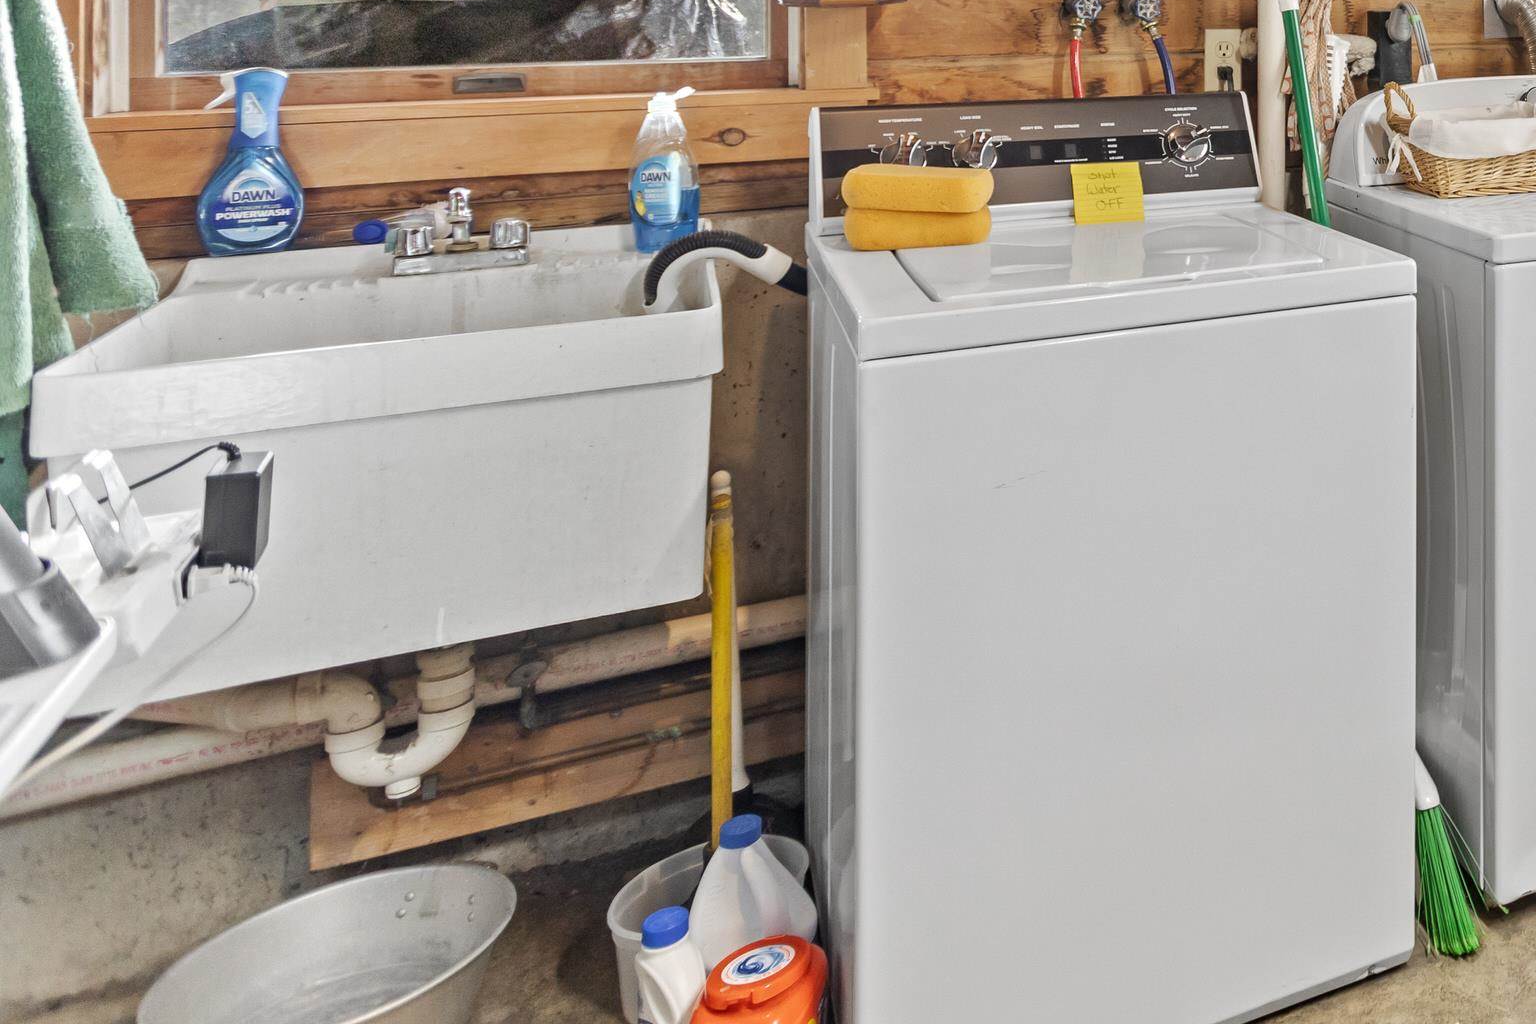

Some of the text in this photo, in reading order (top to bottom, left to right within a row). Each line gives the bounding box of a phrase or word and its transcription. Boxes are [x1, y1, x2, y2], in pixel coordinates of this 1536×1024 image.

[641, 171, 671, 183] DAWN
[231, 189, 276, 203] DAWN
[215, 208, 292, 221] POWERWASH
